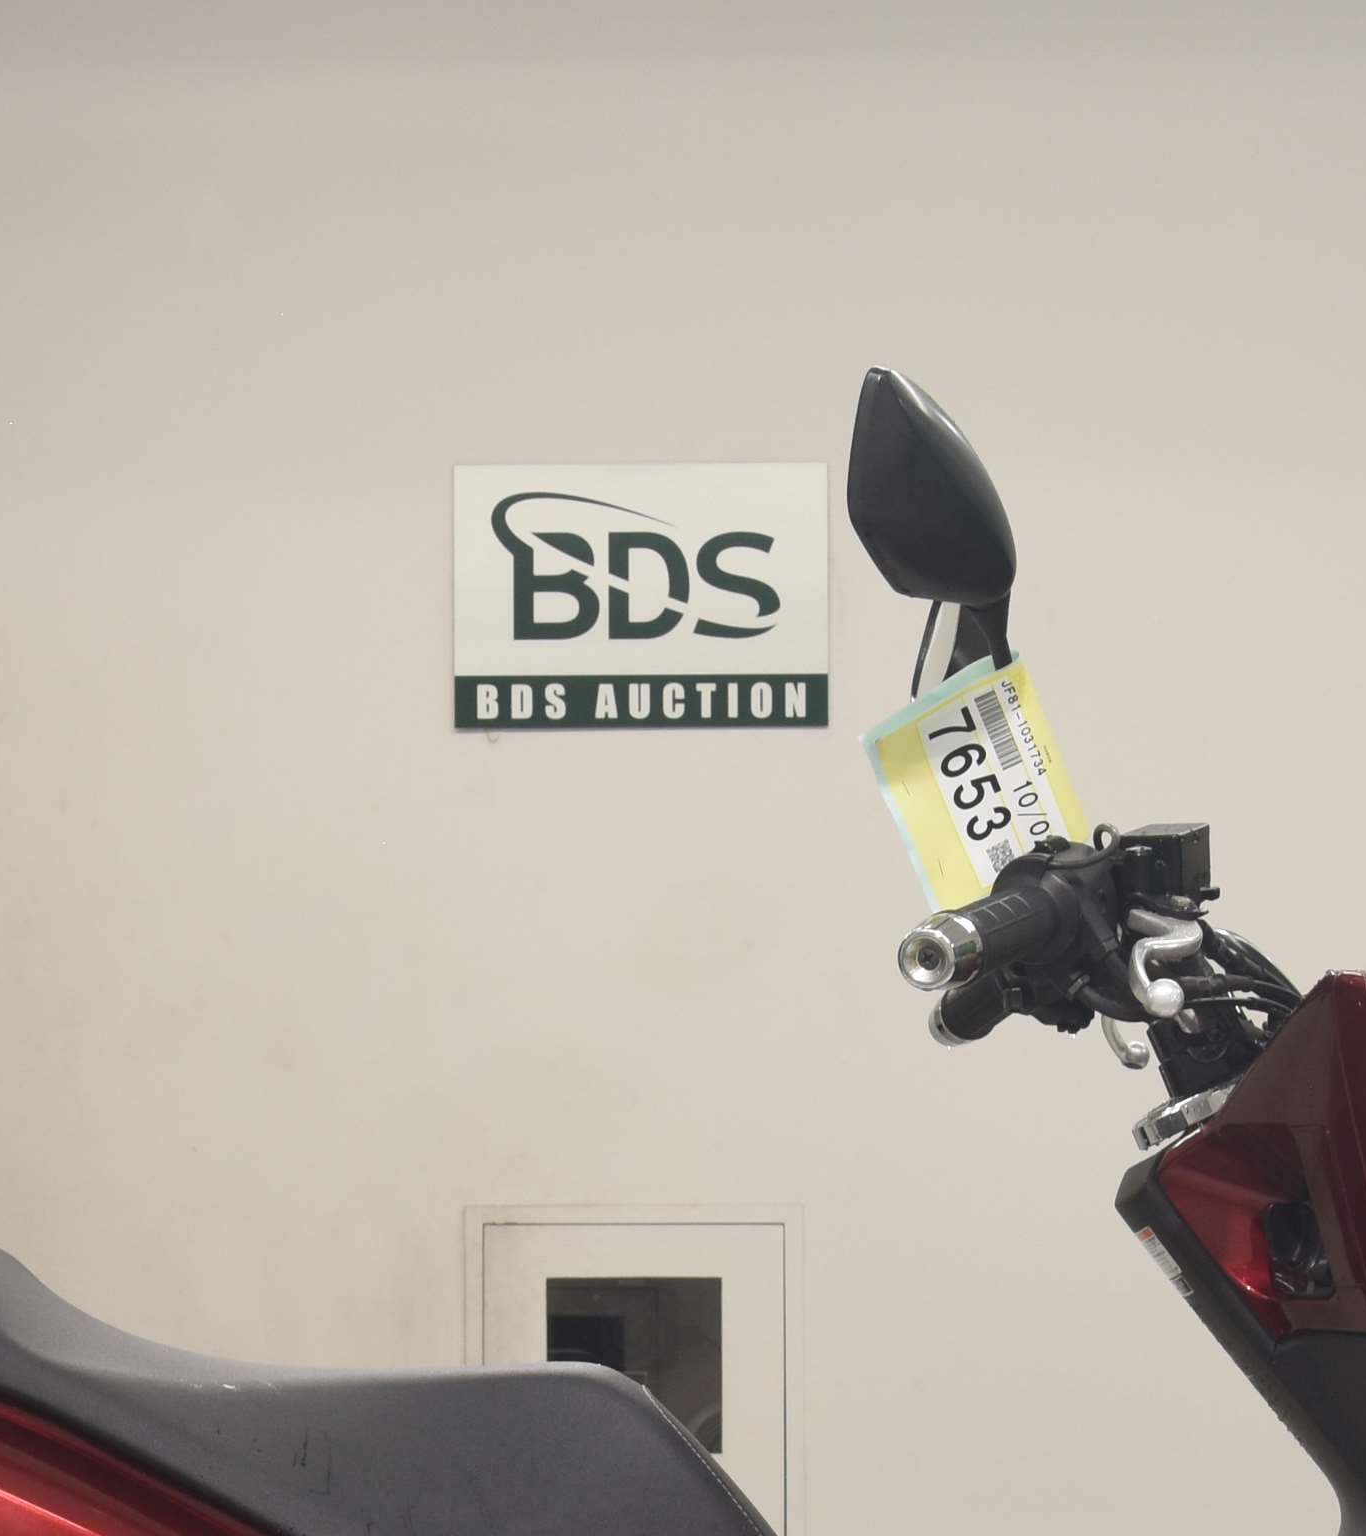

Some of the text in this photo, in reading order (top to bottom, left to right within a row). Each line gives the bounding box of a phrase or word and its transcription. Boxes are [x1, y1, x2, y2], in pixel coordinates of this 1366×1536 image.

[491, 492, 781, 640] BDS
[475, 681, 807, 720] BDS AUCTION
[1001, 680, 1047, 776] JF81-1031734
[928, 705, 1012, 841] 7653
[1012, 780, 1051, 842] 10/0
